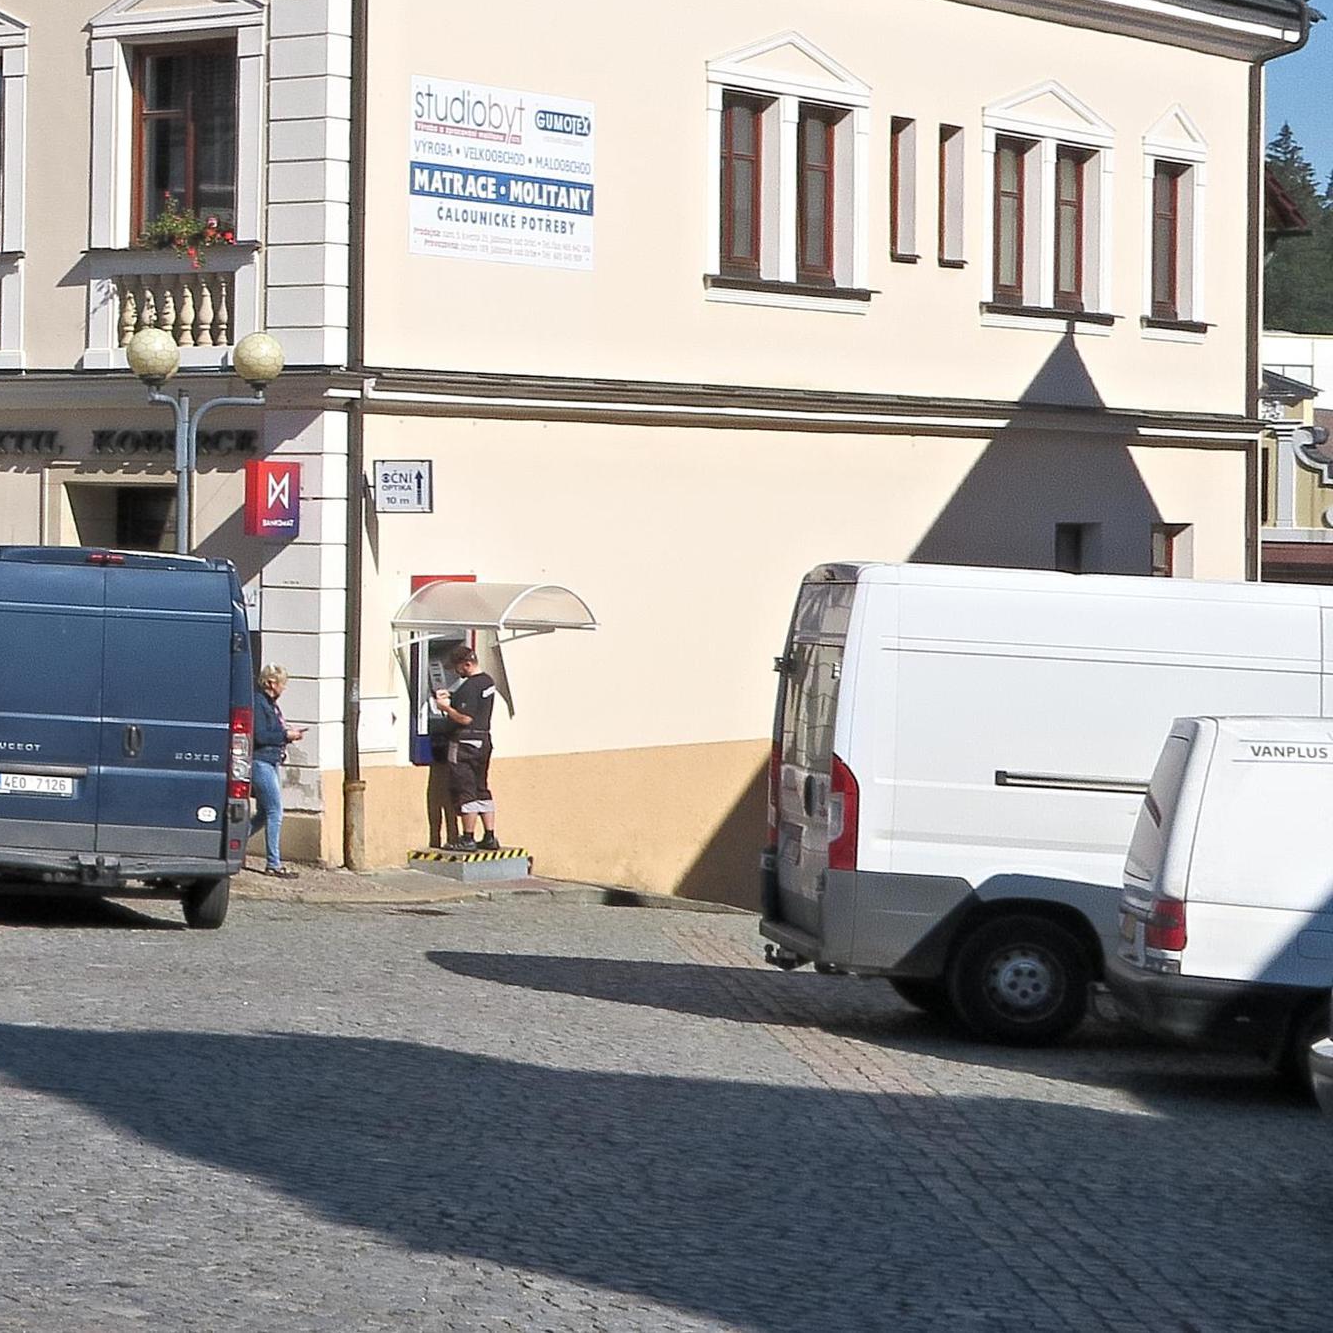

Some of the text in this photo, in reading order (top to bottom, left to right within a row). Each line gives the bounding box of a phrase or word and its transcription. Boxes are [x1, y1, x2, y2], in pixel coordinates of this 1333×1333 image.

[414, 84, 525, 144] studiobyt
[536, 111, 590, 135] GUMOTEX
[414, 138, 591, 175] VÝROBA VELKOOBCHOD MALOOBCHOD
[414, 168, 591, 211] MATRACE MOLITANY
[381, 484, 412, 492] OPTIKA
[385, 496, 396, 504] 10
[174, 752, 220, 762] BOXER
[1249, 745, 1329, 759] VANPLUS
[36, 777, 67, 791] 7126
